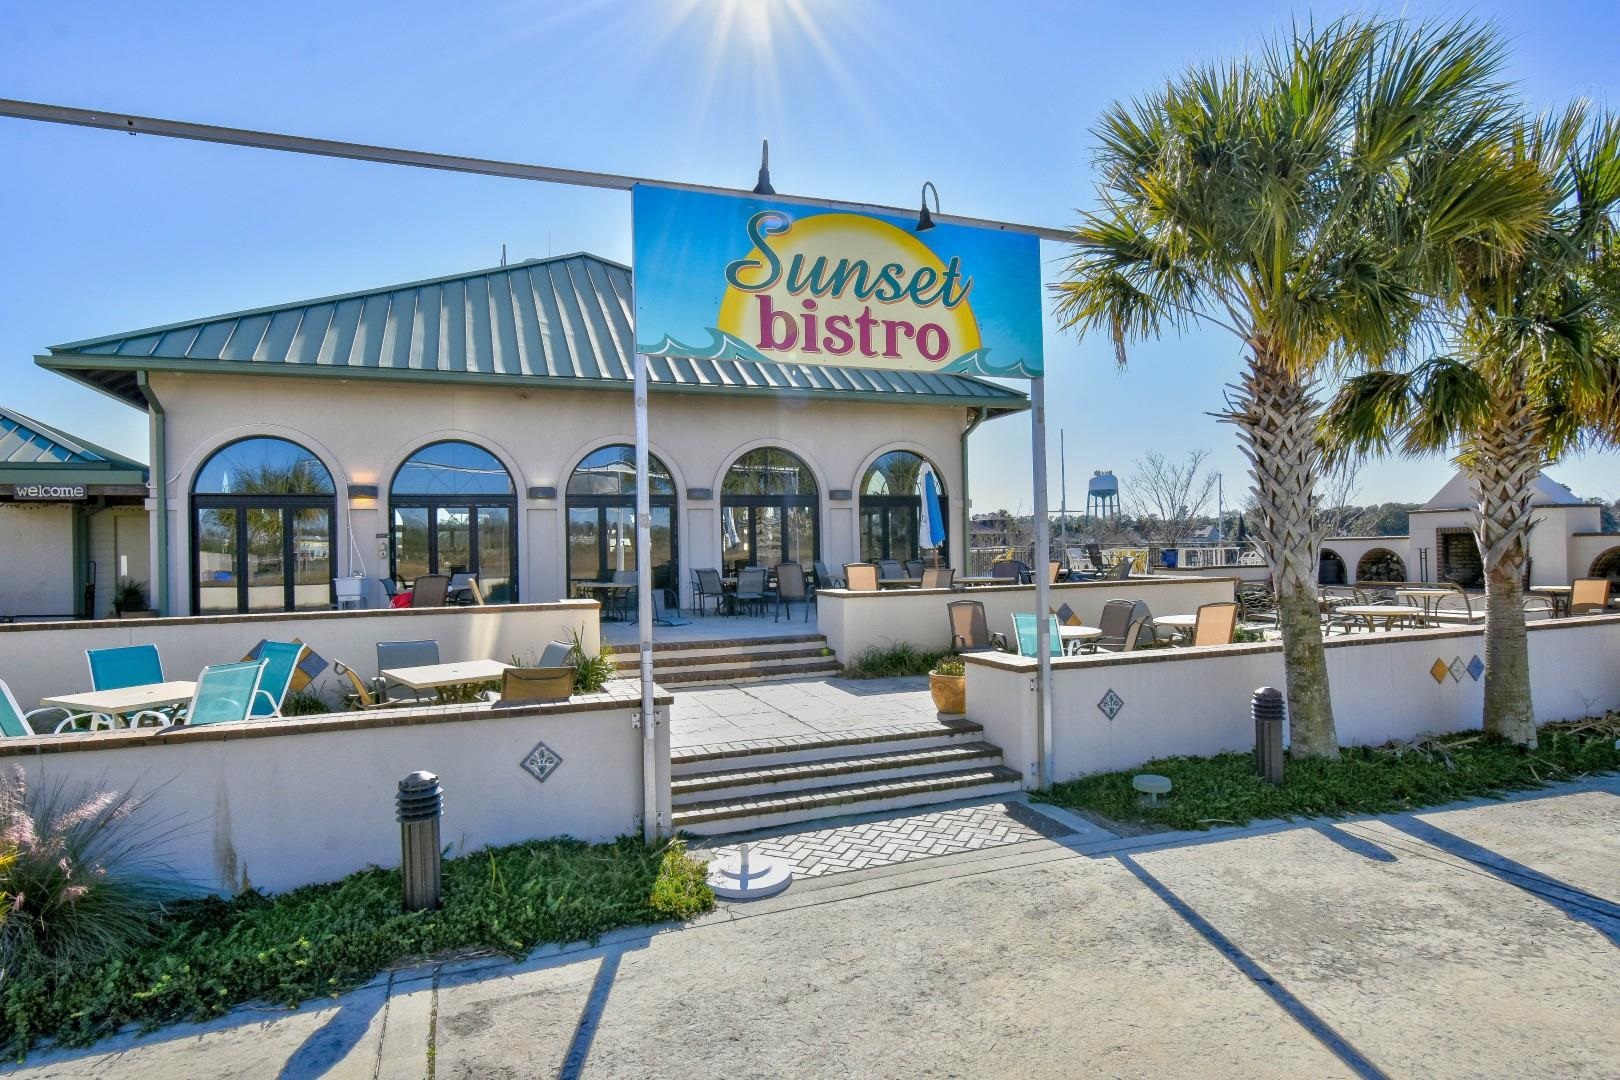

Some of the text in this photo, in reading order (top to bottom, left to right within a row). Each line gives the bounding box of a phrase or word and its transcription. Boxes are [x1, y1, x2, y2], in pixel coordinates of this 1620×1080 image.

[725, 210, 972, 309] Sunset
[755, 294, 950, 362] bistro
[16, 485, 84, 497] welcome
